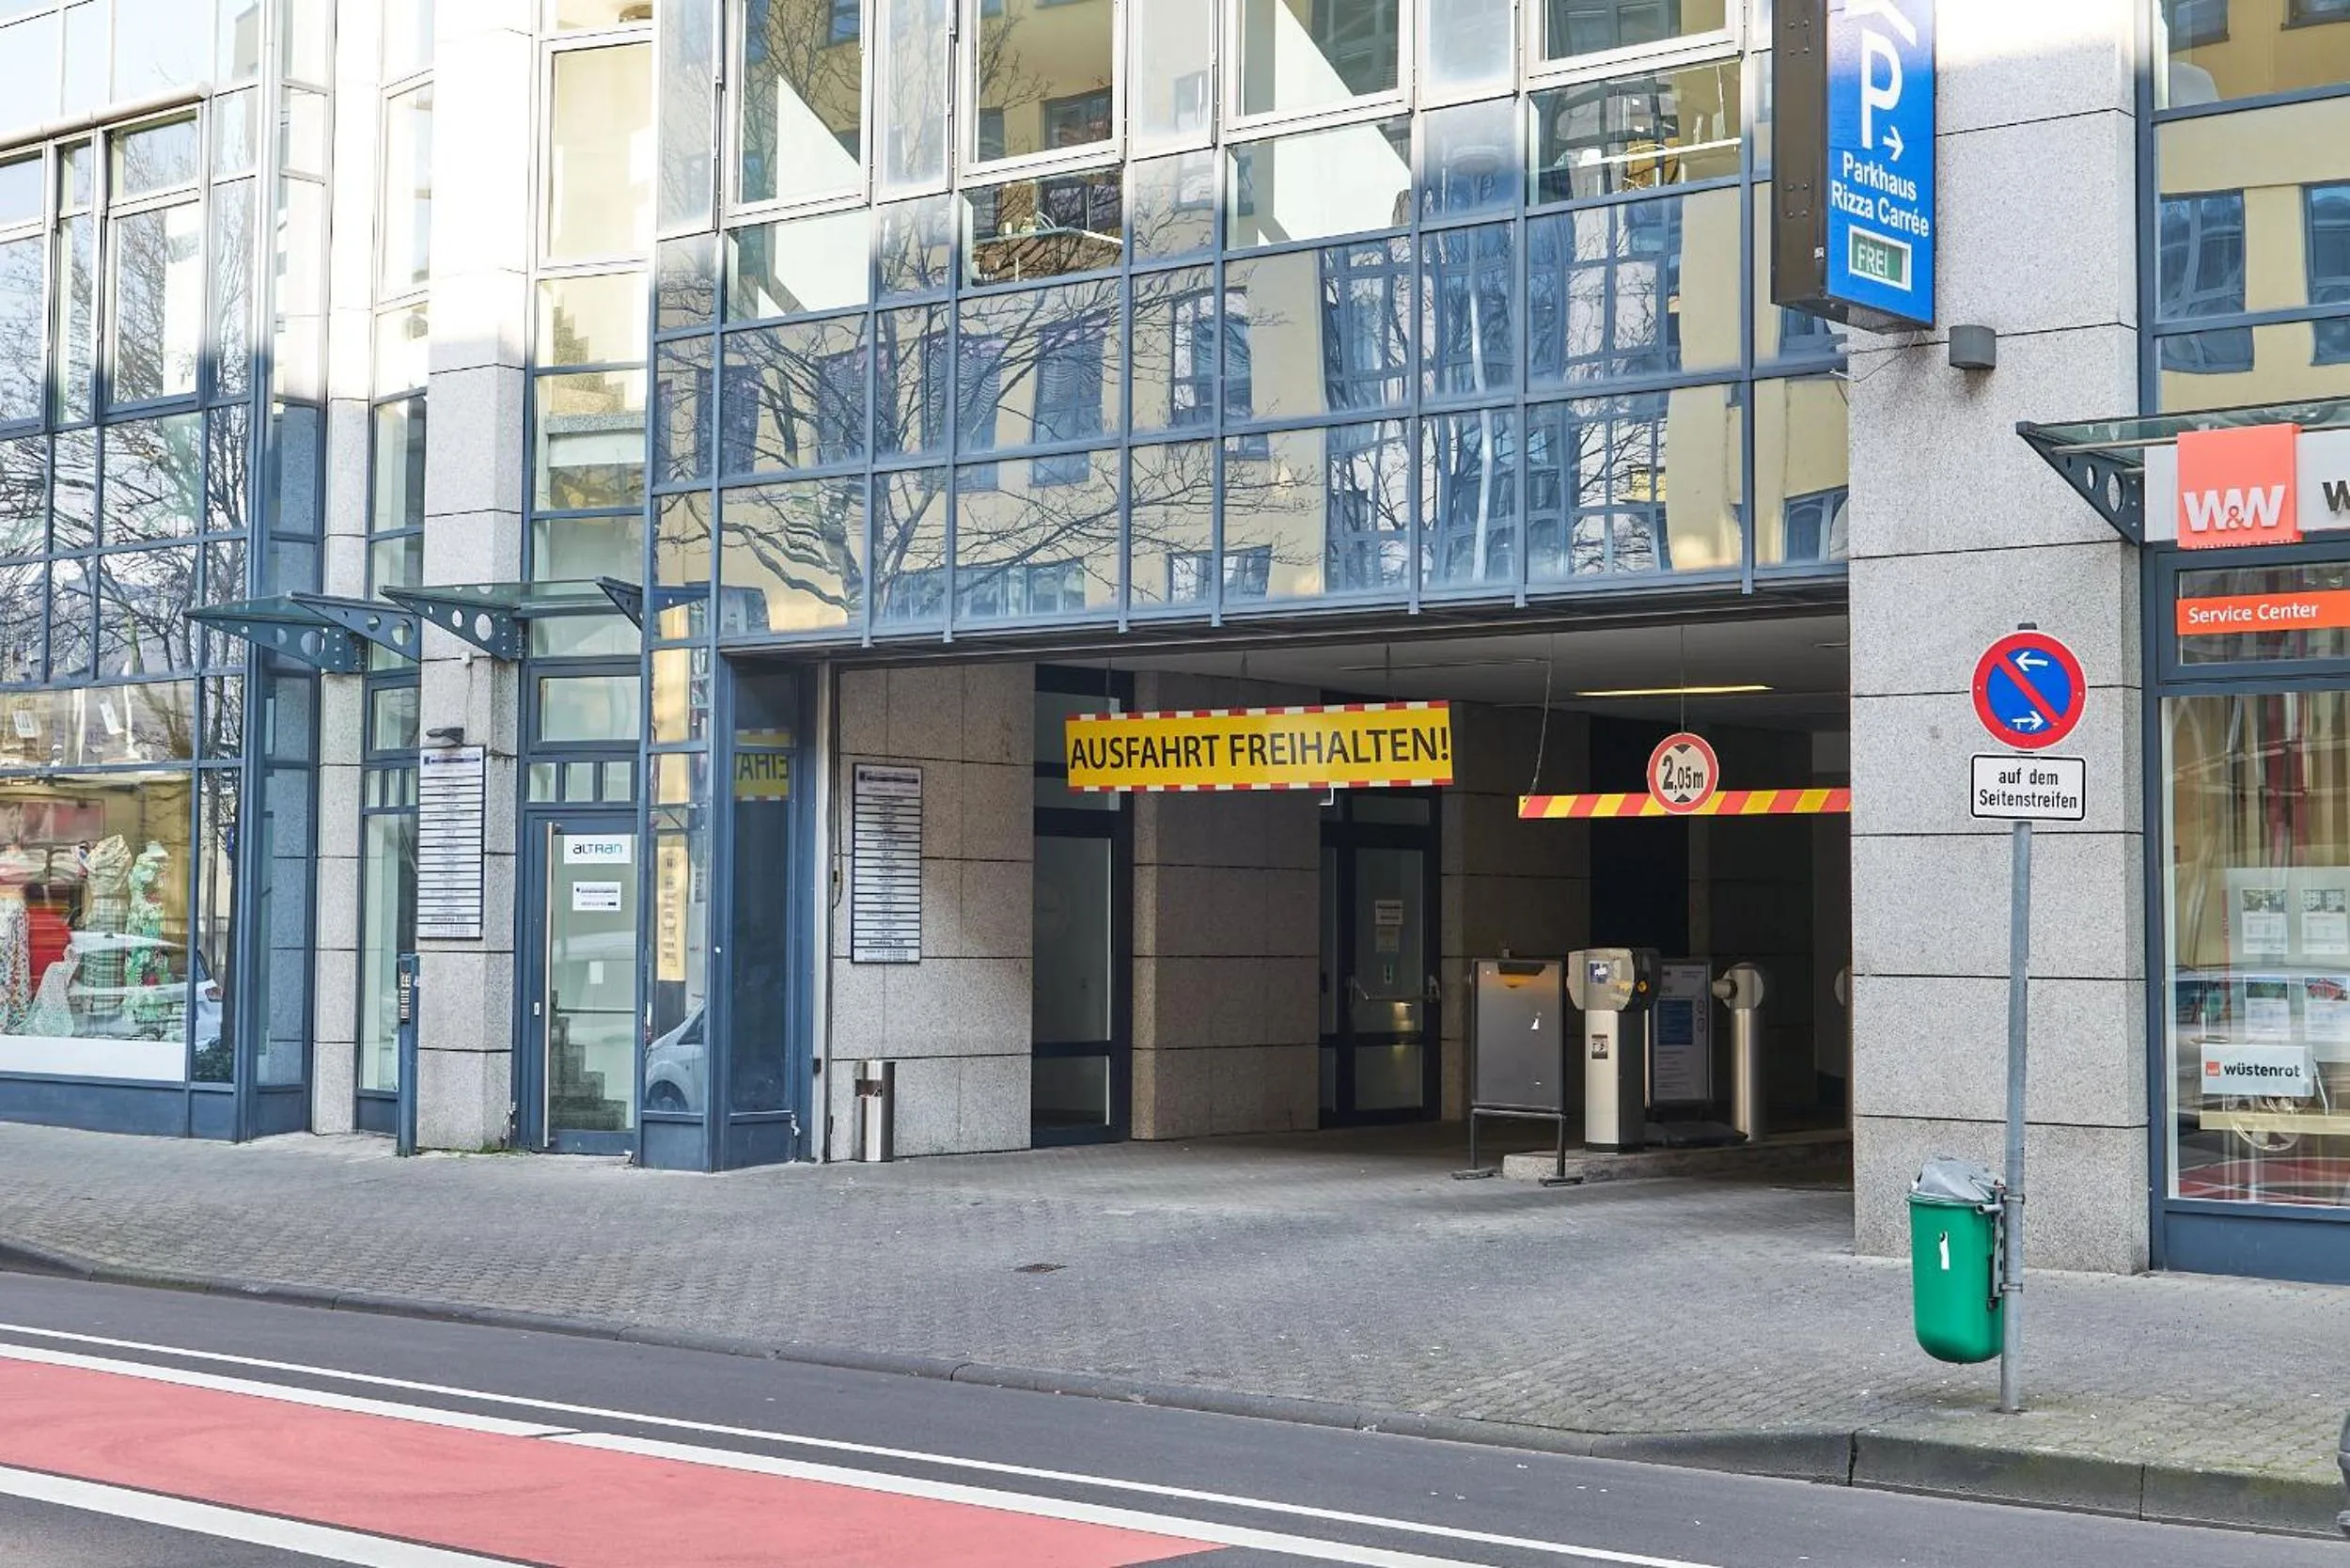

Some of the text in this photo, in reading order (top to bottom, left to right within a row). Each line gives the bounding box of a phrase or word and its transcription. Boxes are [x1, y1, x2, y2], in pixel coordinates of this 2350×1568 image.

[1860, 27, 1904, 150] P
[1842, 150, 1918, 202] Parkhaus
[1830, 180, 1930, 239] Rizza Carrée
[1856, 243, 1890, 278] FREI
[2183, 483, 2286, 532] W&W
[2187, 602, 2320, 624] Service Center
[1070, 726, 1449, 771] AUSFAHRT FREIHALTEN!
[1998, 767, 2059, 786] auf dem
[1979, 789, 2077, 809] Seitenstreifen
[2223, 1062, 2301, 1077] wüstenrot
